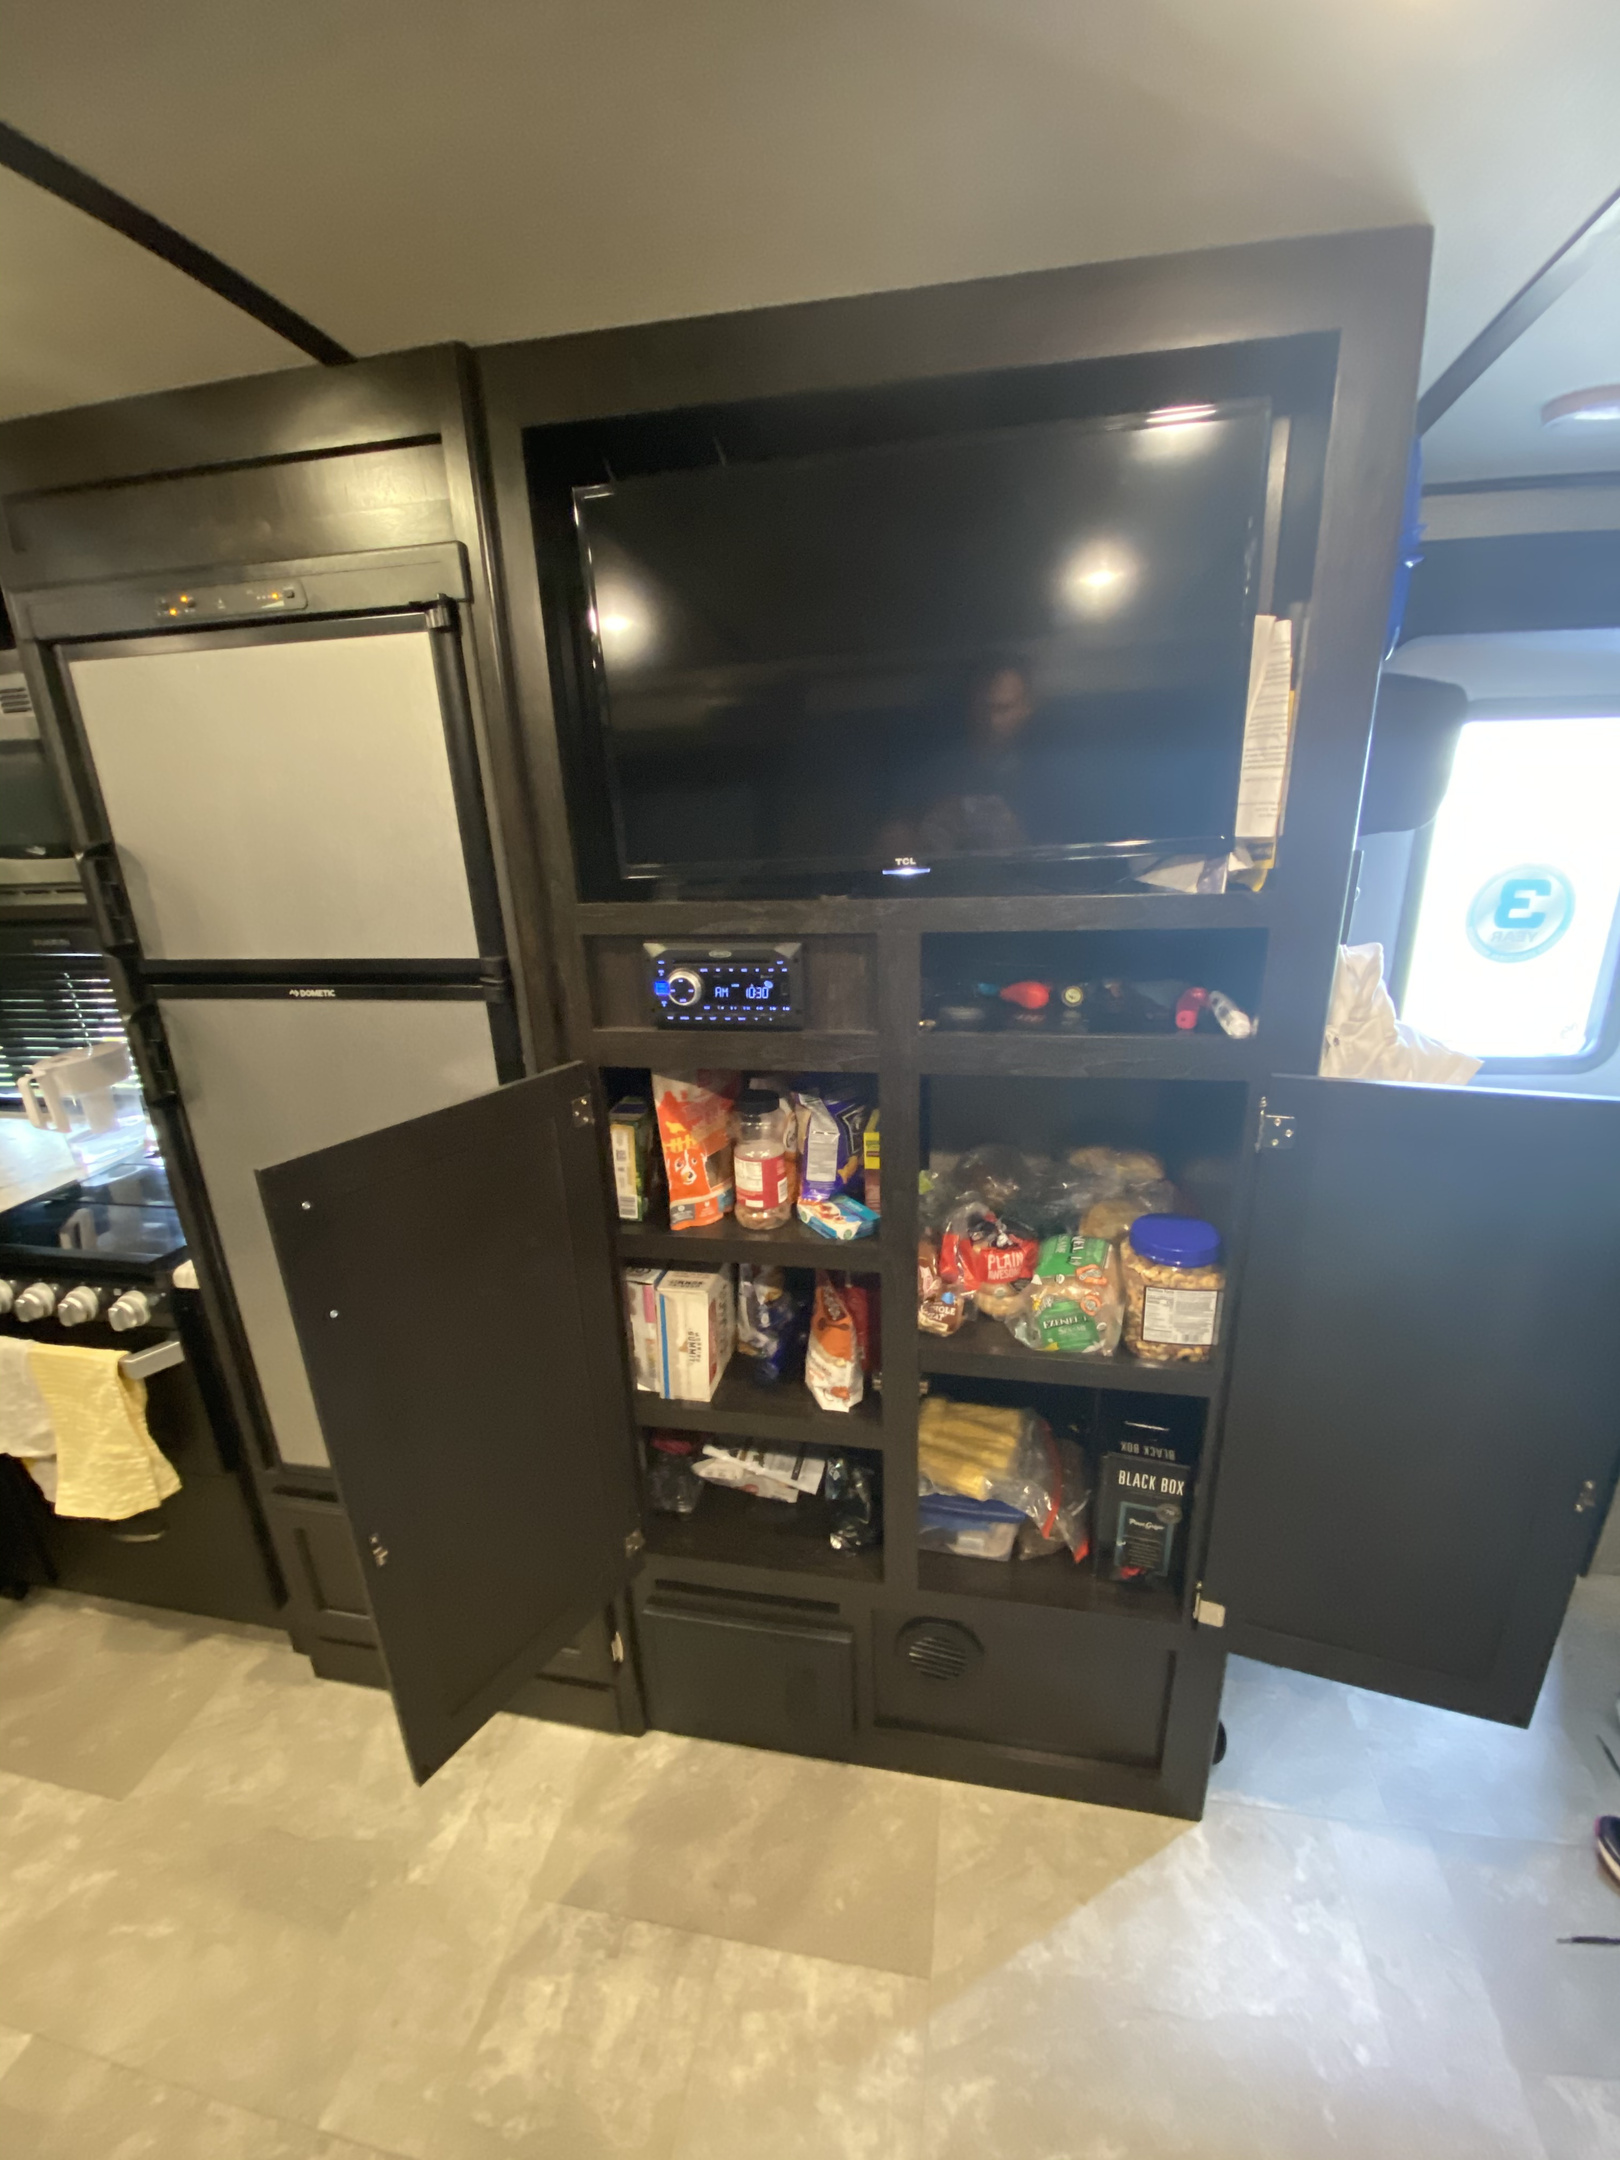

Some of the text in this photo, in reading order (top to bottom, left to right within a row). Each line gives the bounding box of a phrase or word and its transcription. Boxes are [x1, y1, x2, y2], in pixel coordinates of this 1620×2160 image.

[895, 857, 916, 866] TCL
[299, 989, 336, 997] DOMETIC
[714, 986, 729, 998] AM
[987, 1251, 1024, 1270] PLAIN
[1120, 1440, 1176, 1461] BLACK BOX
[1118, 1469, 1185, 1496] BLACK BOX
